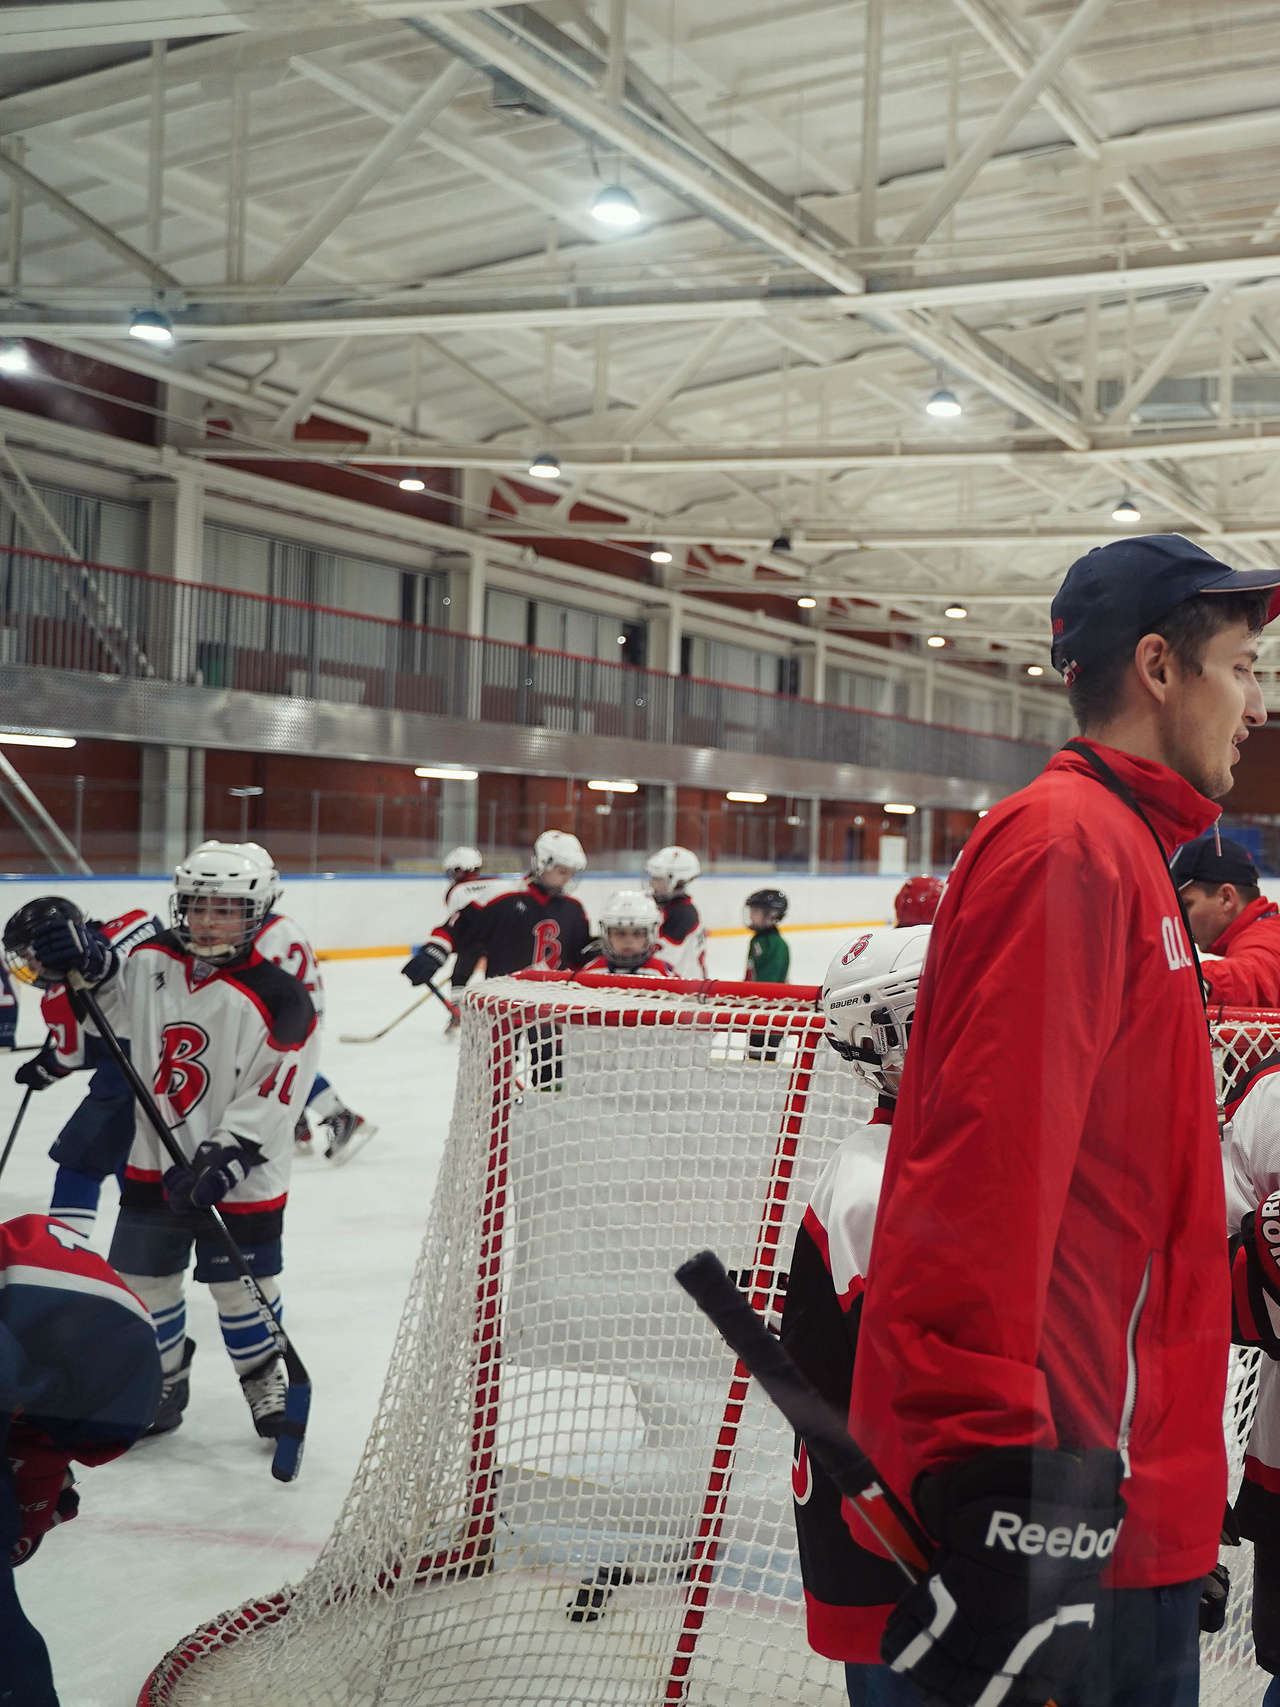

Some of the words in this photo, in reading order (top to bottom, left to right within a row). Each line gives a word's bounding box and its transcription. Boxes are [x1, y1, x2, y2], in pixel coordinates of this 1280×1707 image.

[829, 997, 859, 1010] BAUER
[154, 1021, 211, 1130] B
[984, 1510, 1124, 1560] Reebo
